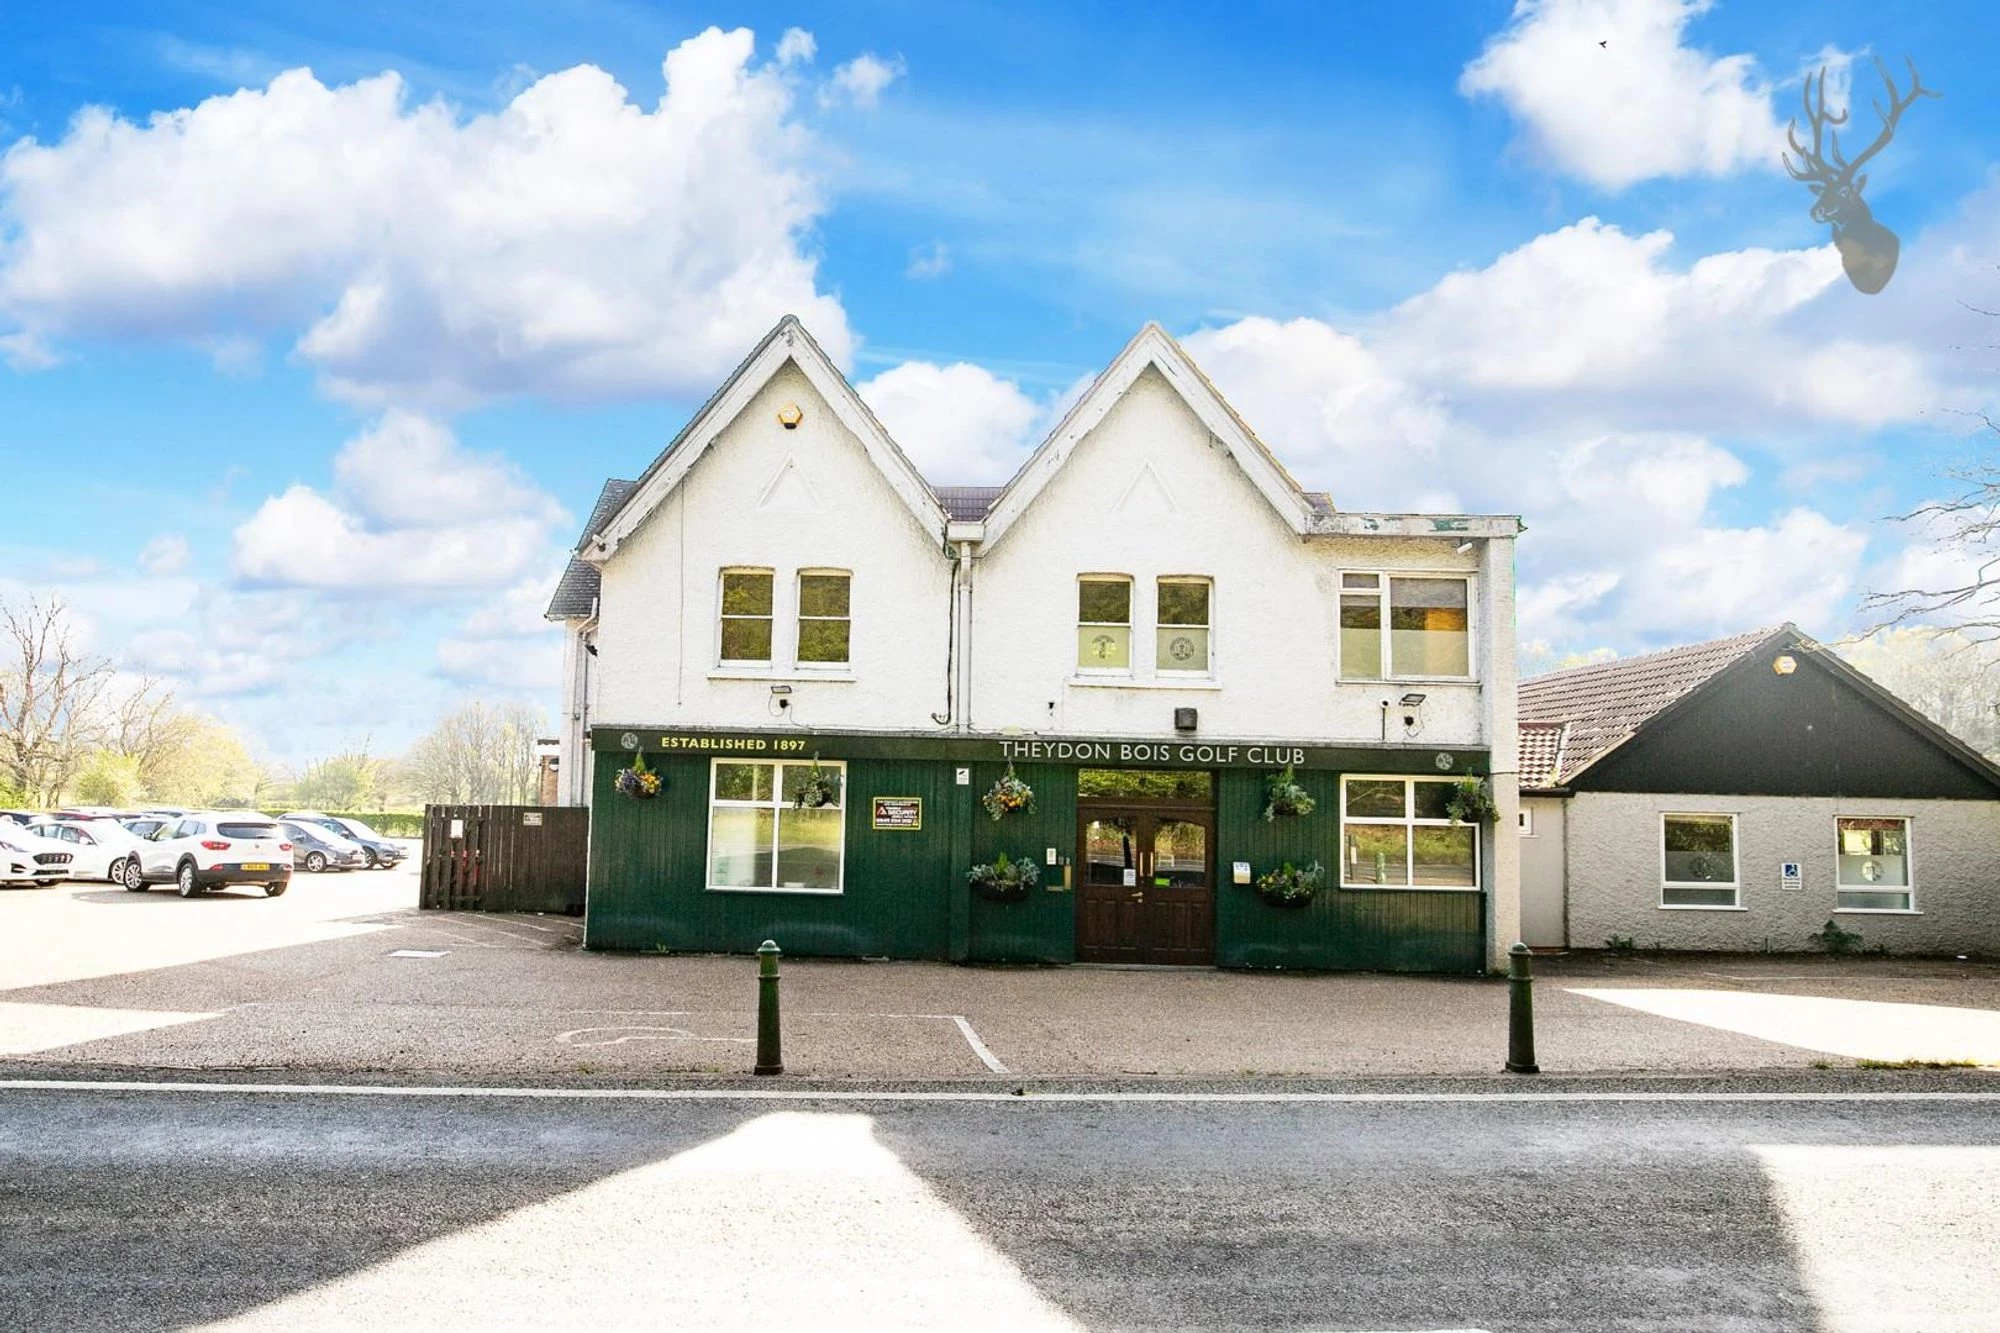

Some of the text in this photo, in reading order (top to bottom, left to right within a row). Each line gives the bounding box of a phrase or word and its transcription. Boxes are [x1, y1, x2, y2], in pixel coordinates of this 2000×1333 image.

[661, 737, 806, 751] ESTABLISHED 1897
[999, 741, 1305, 764] THEYDON BOIS GOLF CLUB
